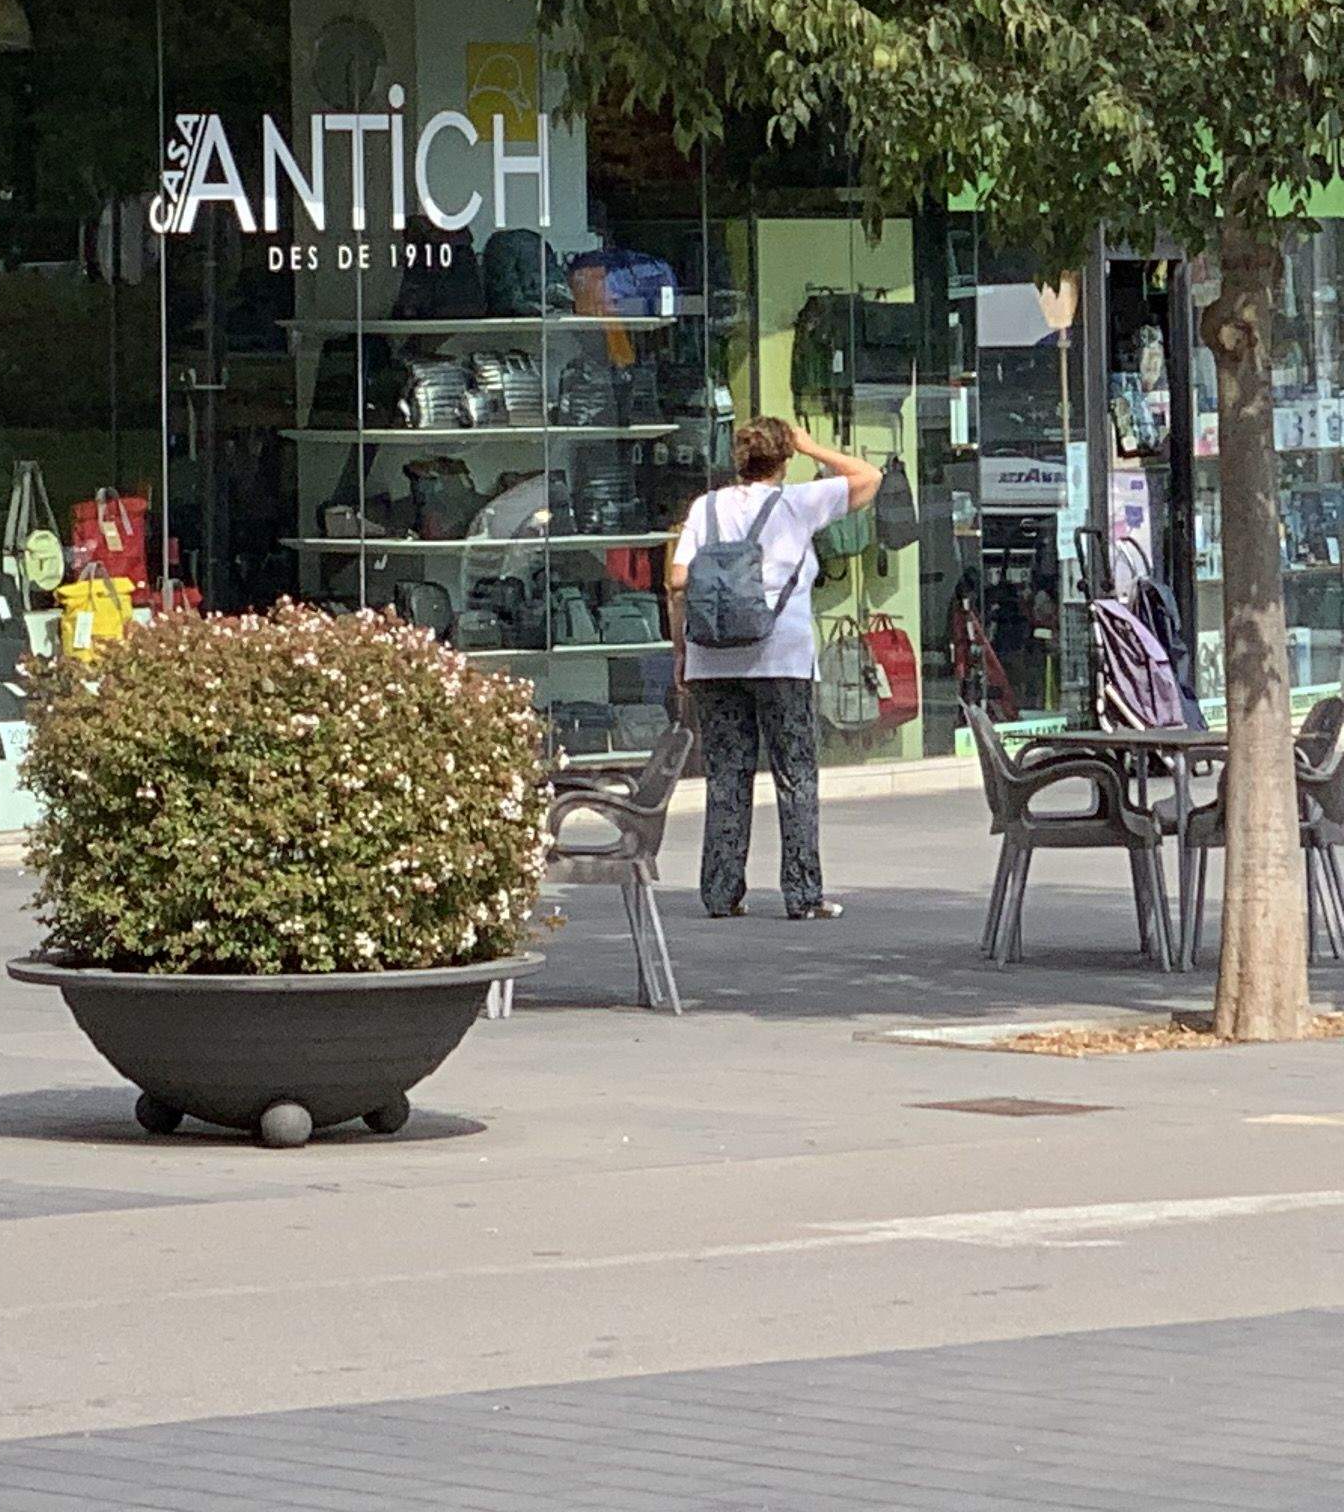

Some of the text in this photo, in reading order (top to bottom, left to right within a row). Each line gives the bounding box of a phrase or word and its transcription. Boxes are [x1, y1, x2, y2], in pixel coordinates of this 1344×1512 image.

[148, 113, 202, 234] CASA
[267, 243, 453, 272] DES DE 1910
